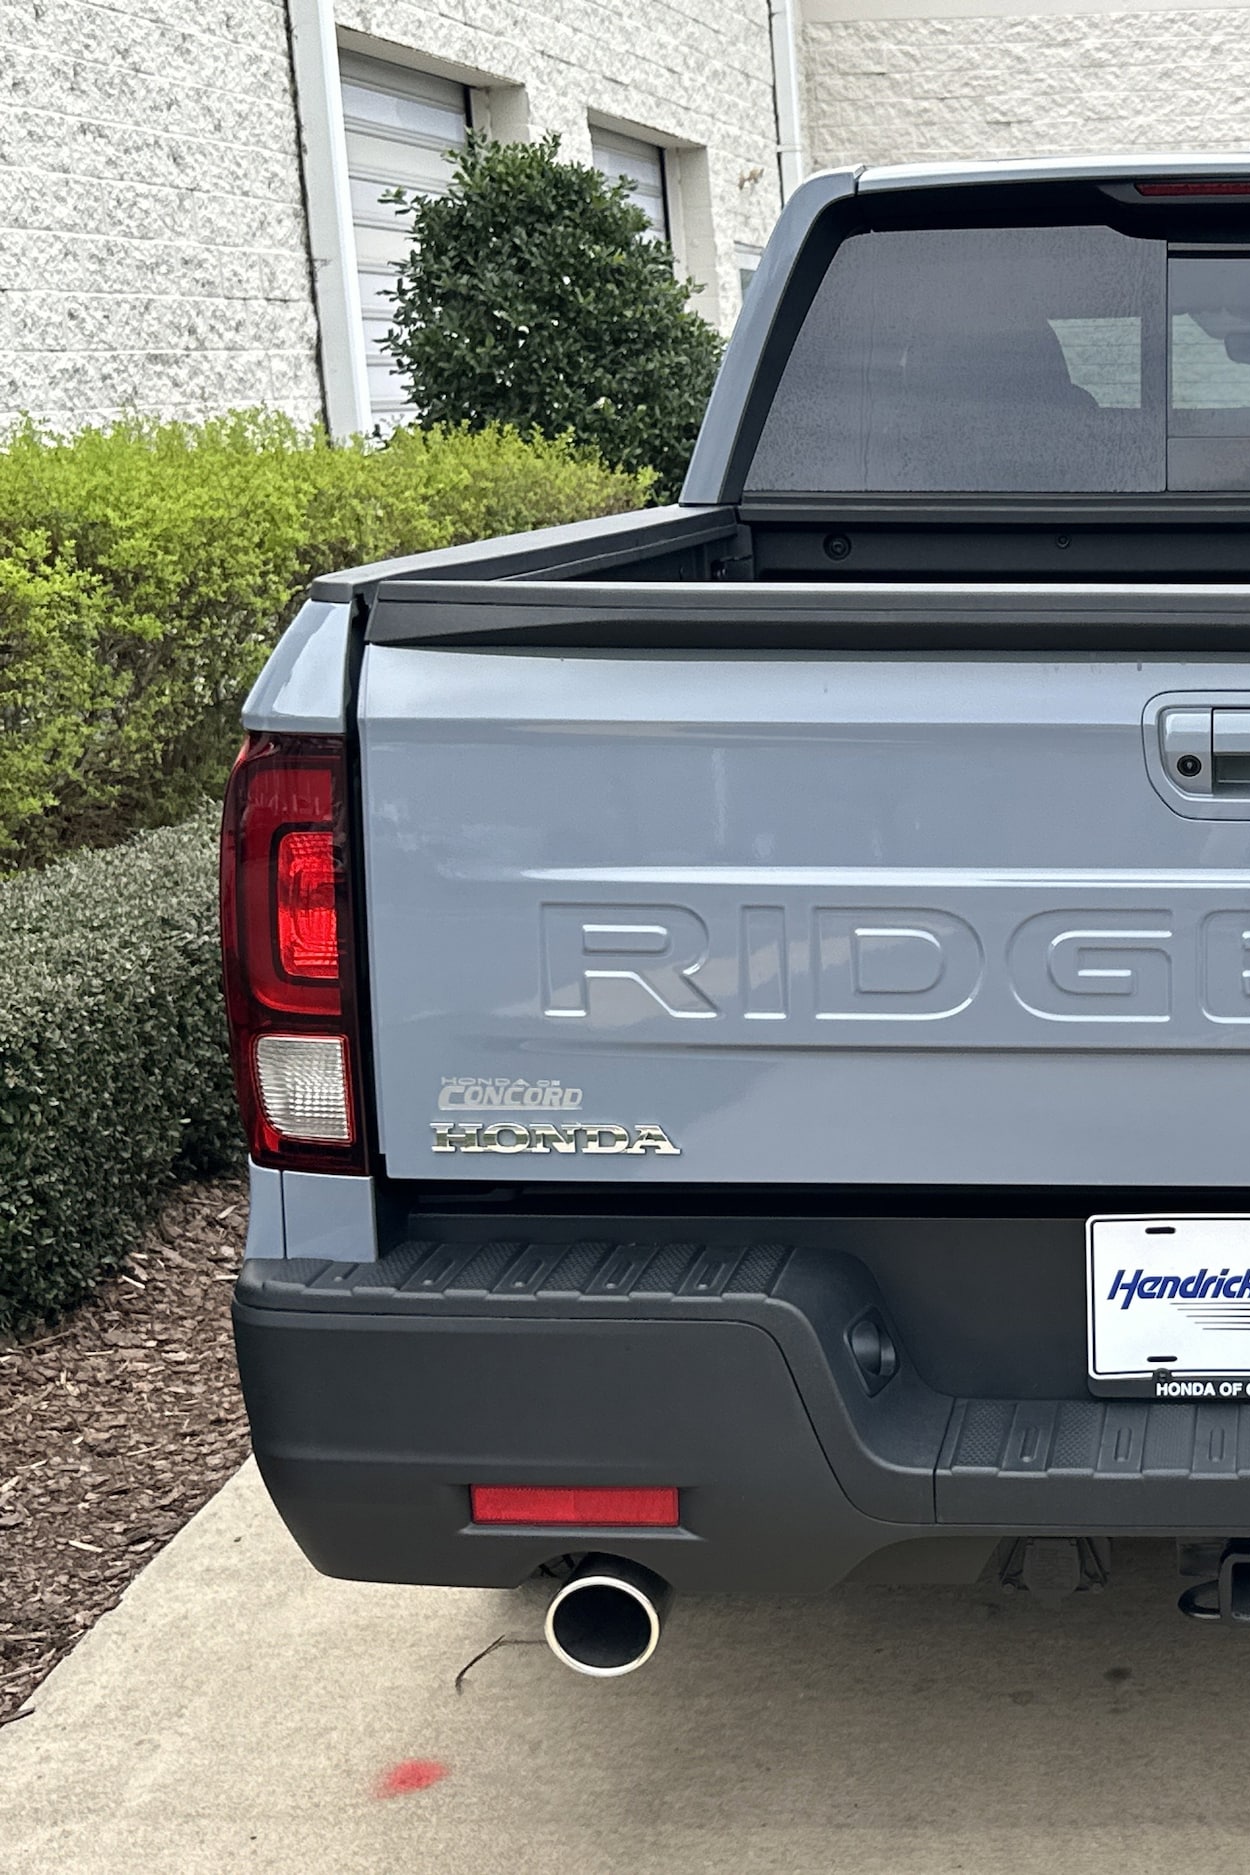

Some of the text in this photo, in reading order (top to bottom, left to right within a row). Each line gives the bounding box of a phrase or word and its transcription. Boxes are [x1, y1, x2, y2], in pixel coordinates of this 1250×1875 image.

[440, 1076, 531, 1087] HONDA
[438, 1085, 583, 1109] CONCORD
[430, 1121, 682, 1155] HONDA
[1156, 1382, 1216, 1397] HONDA
[1219, 1382, 1243, 1397] OF
